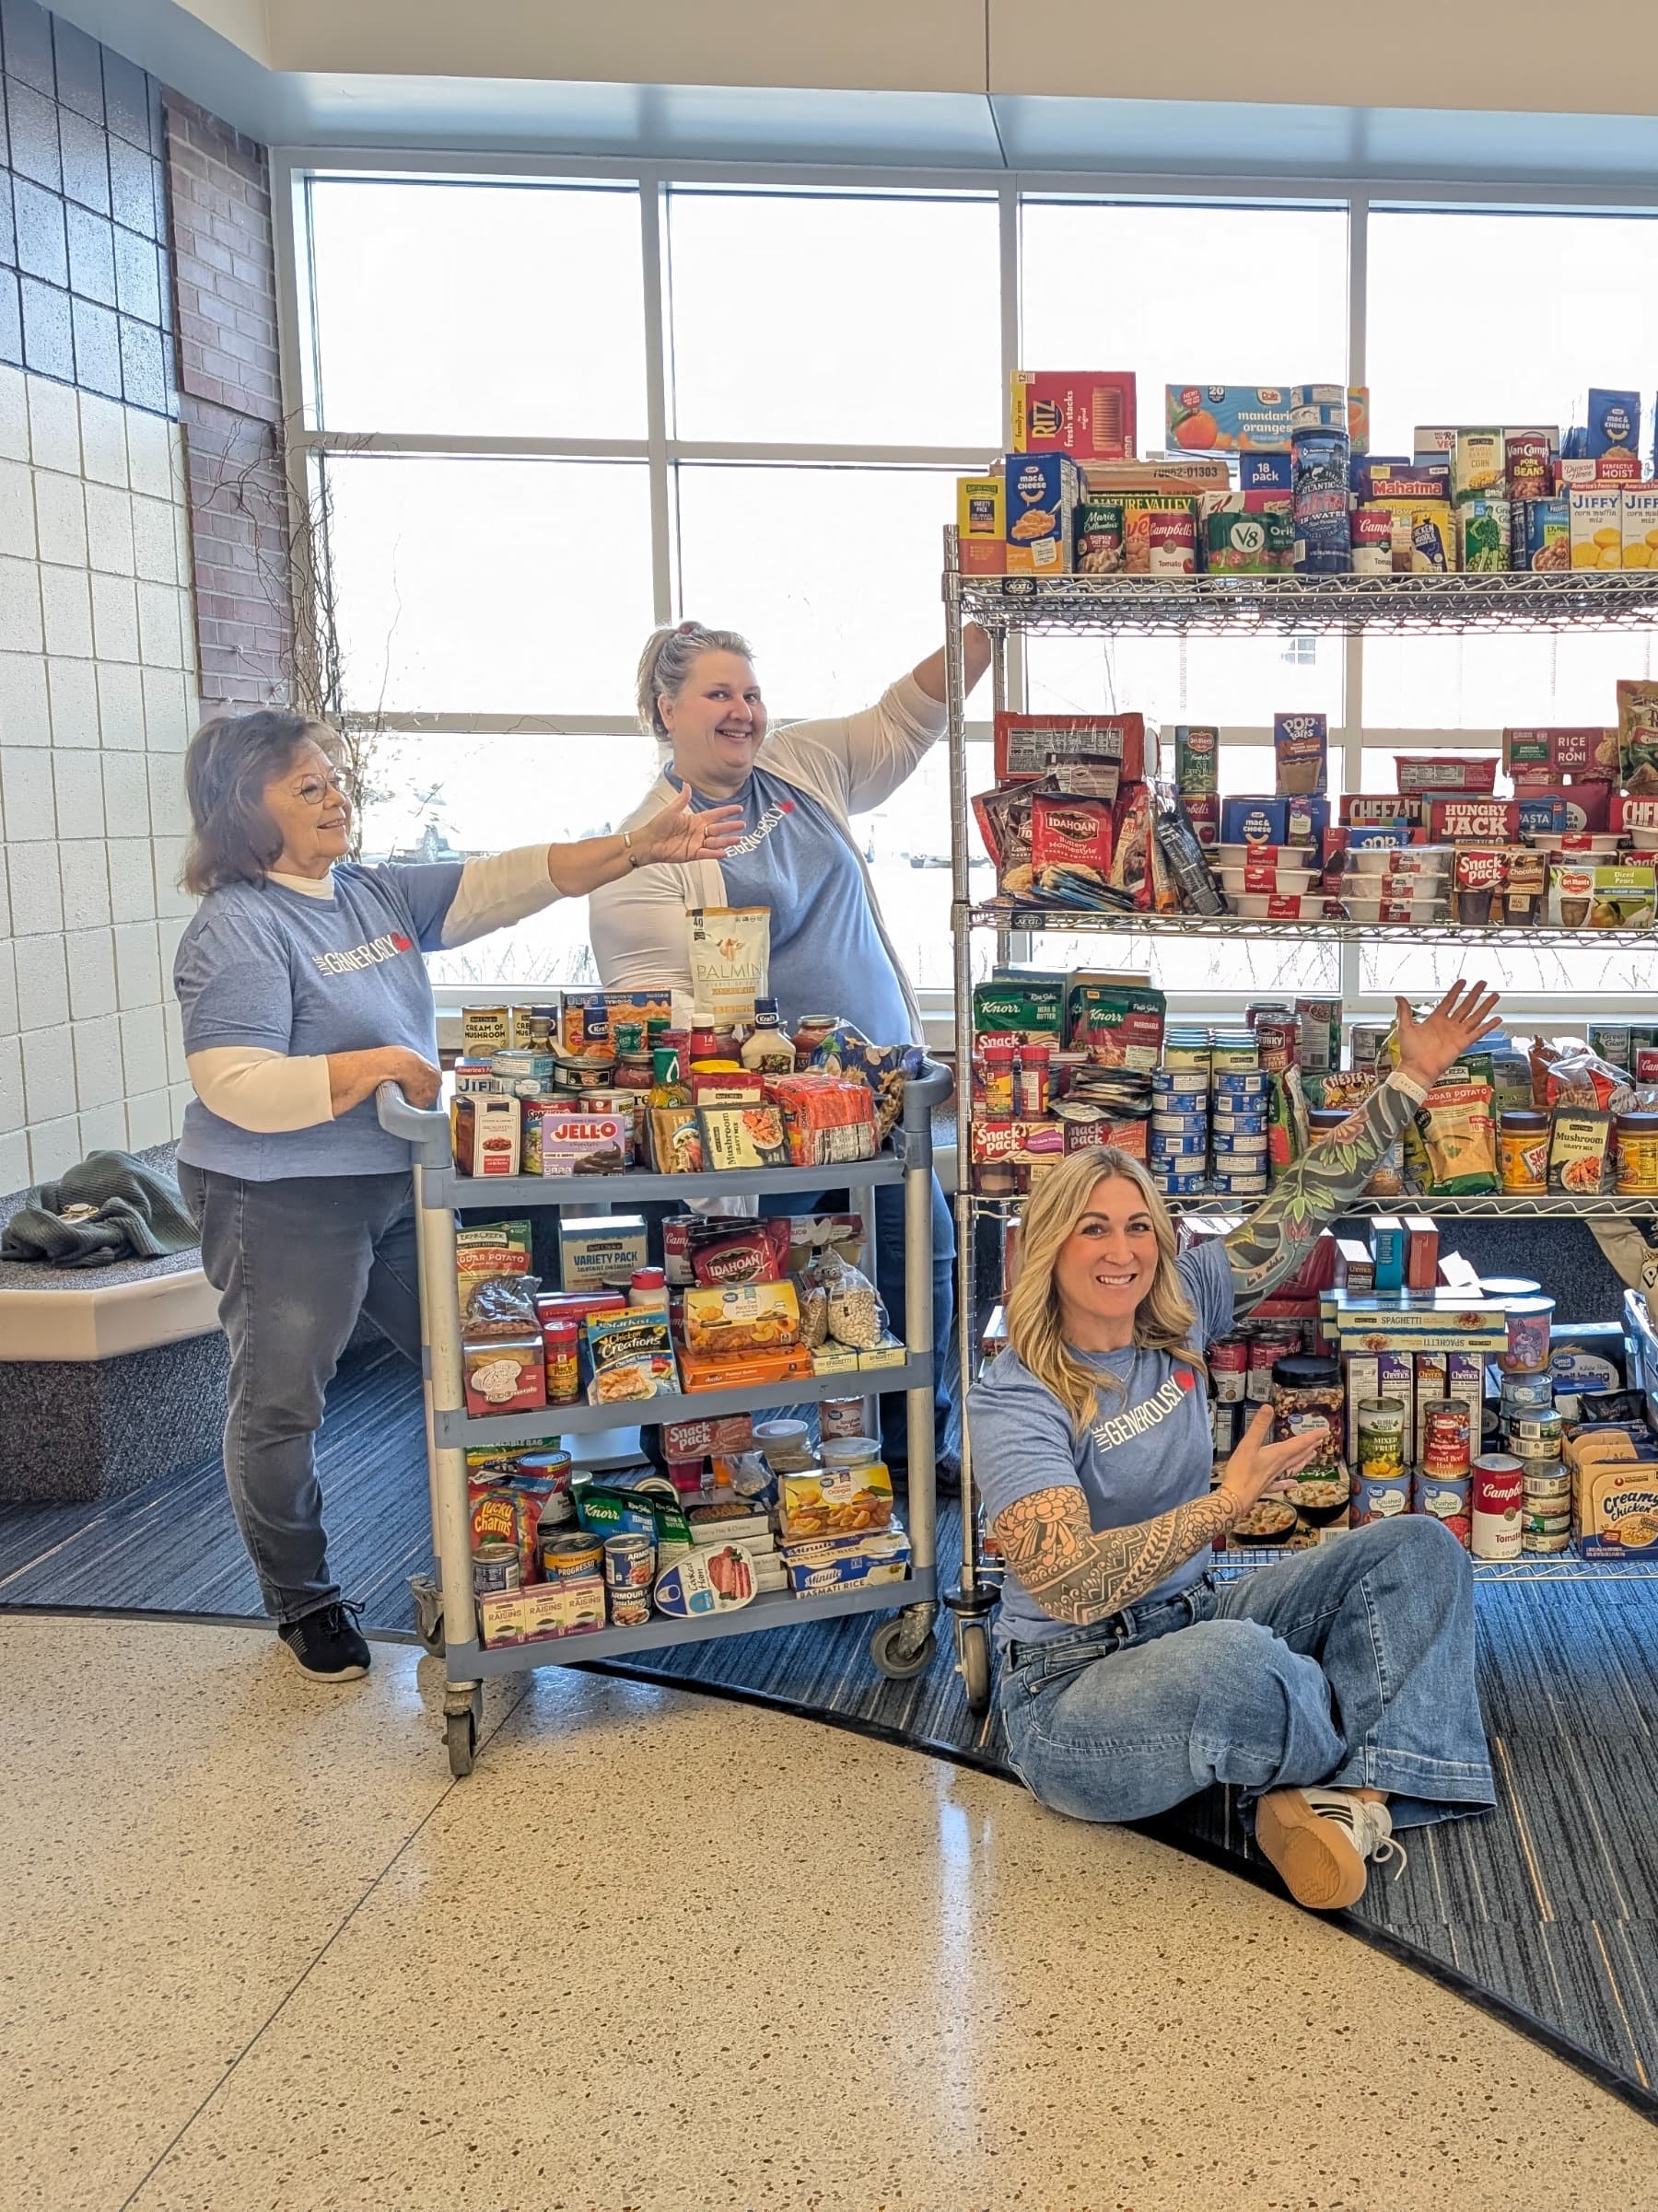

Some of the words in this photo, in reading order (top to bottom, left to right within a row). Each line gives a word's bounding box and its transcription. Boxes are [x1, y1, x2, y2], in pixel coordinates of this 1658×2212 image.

[1208, 386, 1225, 396] 20
[1064, 390, 1074, 417] stacks
[1032, 400, 1057, 438] RITZ
[1238, 411, 1292, 422] mandari
[1064, 420, 1074, 448] fresh
[1256, 462, 1271, 473] 18
[1513, 466, 1546, 477] BEANS
[1253, 471, 1279, 483] pack
[1602, 470, 1634, 479] MOIST
[1372, 480, 1443, 496] Mahatma
[1093, 498, 1144, 510] NATURE
[1144, 497, 1192, 511] VALLEY
[1573, 495, 1620, 508] JIFFY
[1083, 511, 1117, 523] Marie
[1311, 510, 1347, 521] WATER
[1235, 526, 1259, 547] V8
[1158, 559, 1183, 568] Tomato
[1558, 737, 1586, 747] RICE
[1559, 751, 1586, 762] RONI
[1444, 805, 1508, 816] HUNGRY
[1048, 814, 1097, 832] IDAHOAN
[1441, 818, 1510, 836] JACK
[1048, 842, 1098, 855] Homestyle
[1059, 836, 1088, 849] Buttery
[1459, 856, 1503, 873] Snack
[1468, 869, 1501, 884] pack
[1510, 867, 1542, 876] Chocolate
[696, 963, 763, 980] PALMIN
[980, 1002, 1021, 1014] Knorr
[757, 1014, 776, 1022] Kraft
[1089, 1009, 1124, 1022] Knorr
[494, 1023, 505, 1031] OF
[464, 1030, 506, 1039] MUSHROOM
[1454, 1089, 1487, 1098] POTATO
[727, 1112, 736, 1165] Mushroom
[976, 1127, 1021, 1145] Snack
[1070, 1135, 1103, 1149] pack
[1555, 1131, 1604, 1145] Mushroom
[987, 1140, 1021, 1156] pack
[488, 1252, 525, 1263] POTATO
[573, 1252, 613, 1267] VARIETY
[615, 1251, 638, 1263] PACK
[577, 1264, 605, 1273] Instant
[709, 1252, 761, 1278] IDAHOAN
[1382, 1317, 1422, 1325] SPAGHETTI
[609, 1332, 642, 1345] Chicken
[1423, 1339, 1465, 1347] SPAGHETTI
[601, 1335, 661, 1359] Creations
[1383, 1370, 1409, 1380] Cheerios
[1452, 1370, 1479, 1380] Cheerios
[669, 1422, 711, 1440] Snack
[1091, 1418, 1113, 1453] LIVE
[679, 1434, 712, 1450] pack
[1428, 1453, 1449, 1462] Corned
[1450, 1453, 1465, 1462] Beef
[481, 1501, 514, 1518] Lucky
[584, 1503, 620, 1520] Knorr
[1610, 1503, 1652, 1521] chicken
[473, 1514, 513, 1537] Charms
[626, 1550, 649, 1561] ARMO
[558, 1560, 595, 1577] PROGRESSO
[805, 1568, 842, 1587] Minute
[800, 1583, 840, 1599] BASMATI
[842, 1578, 865, 1590] RICE
[568, 1597, 601, 1608] RAISINS
[611, 1591, 644, 1601] ARMOUR
[529, 1602, 563, 1615] RAISINS
[488, 1610, 522, 1621] RAISINS
